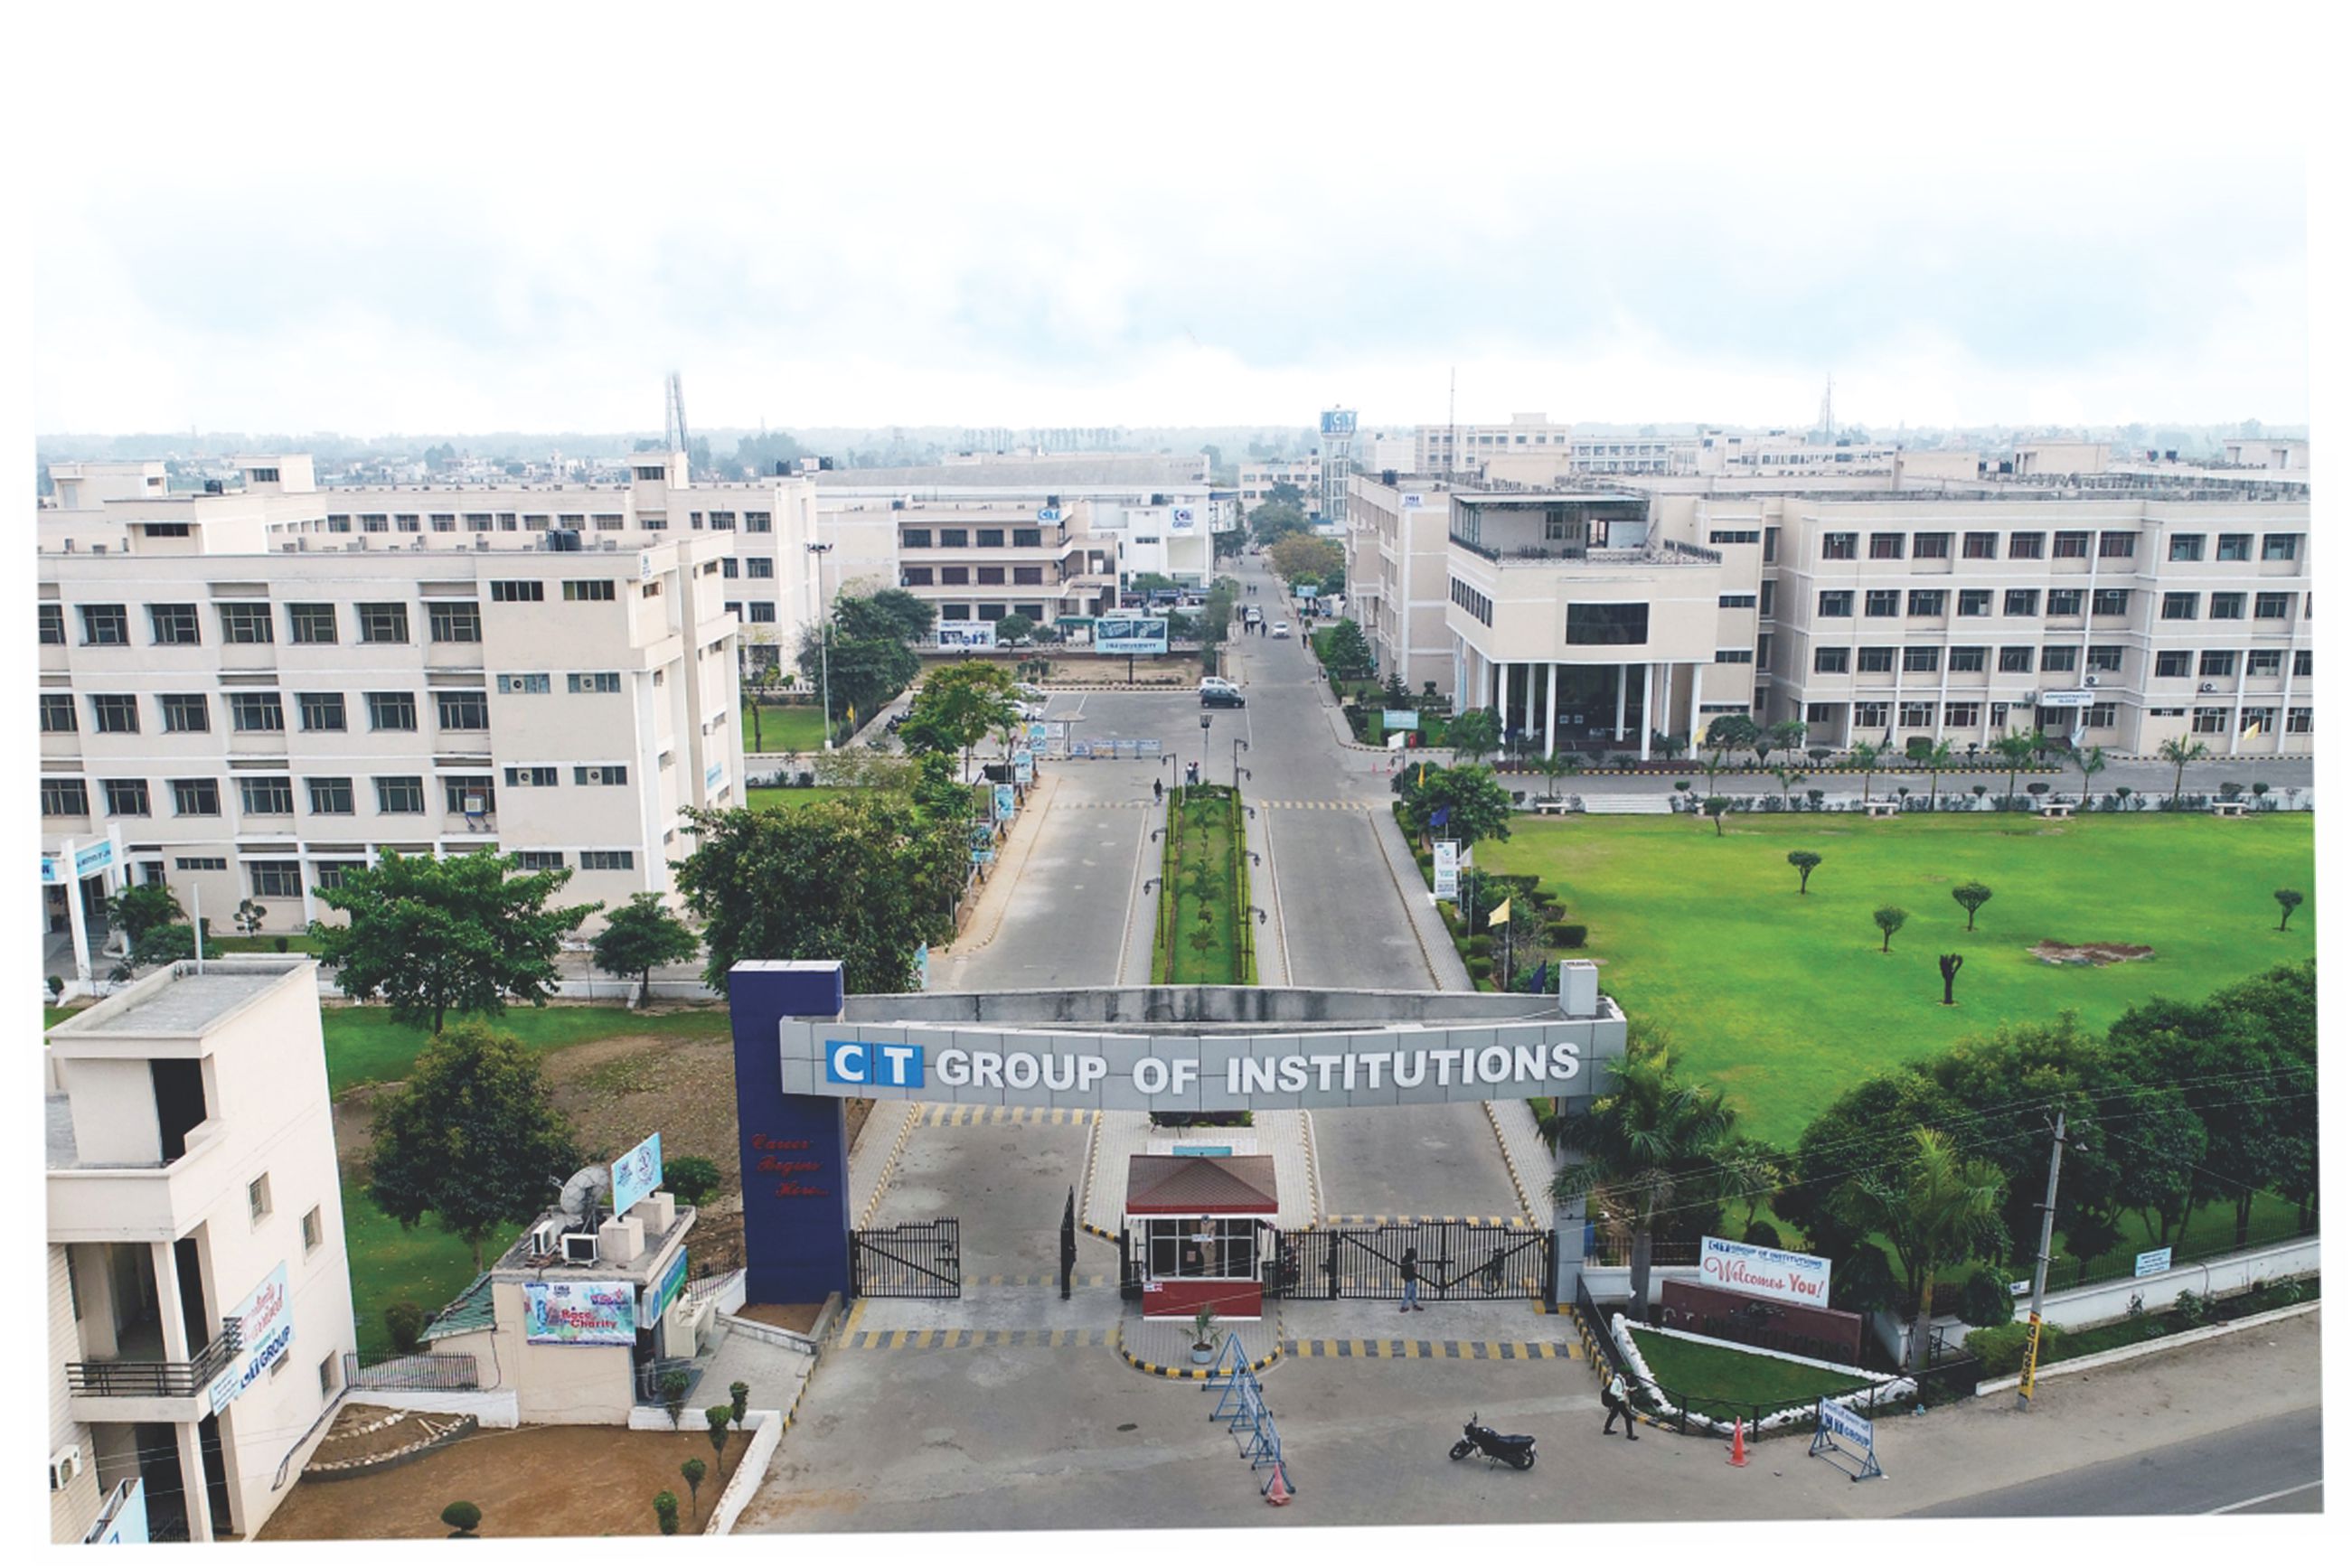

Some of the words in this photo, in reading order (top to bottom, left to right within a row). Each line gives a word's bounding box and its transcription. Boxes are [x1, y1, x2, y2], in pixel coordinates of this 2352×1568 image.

[936, 1049, 1107, 1091] GROUP
[1133, 1057, 1200, 1094] OF
[1228, 1043, 1580, 1094] INSTITUTIONS
[1788, 1272, 1825, 1299] You!
[561, 1309, 594, 1320] Race
[570, 1319, 617, 1329] Charity
[259, 1325, 290, 1368] GROUP
